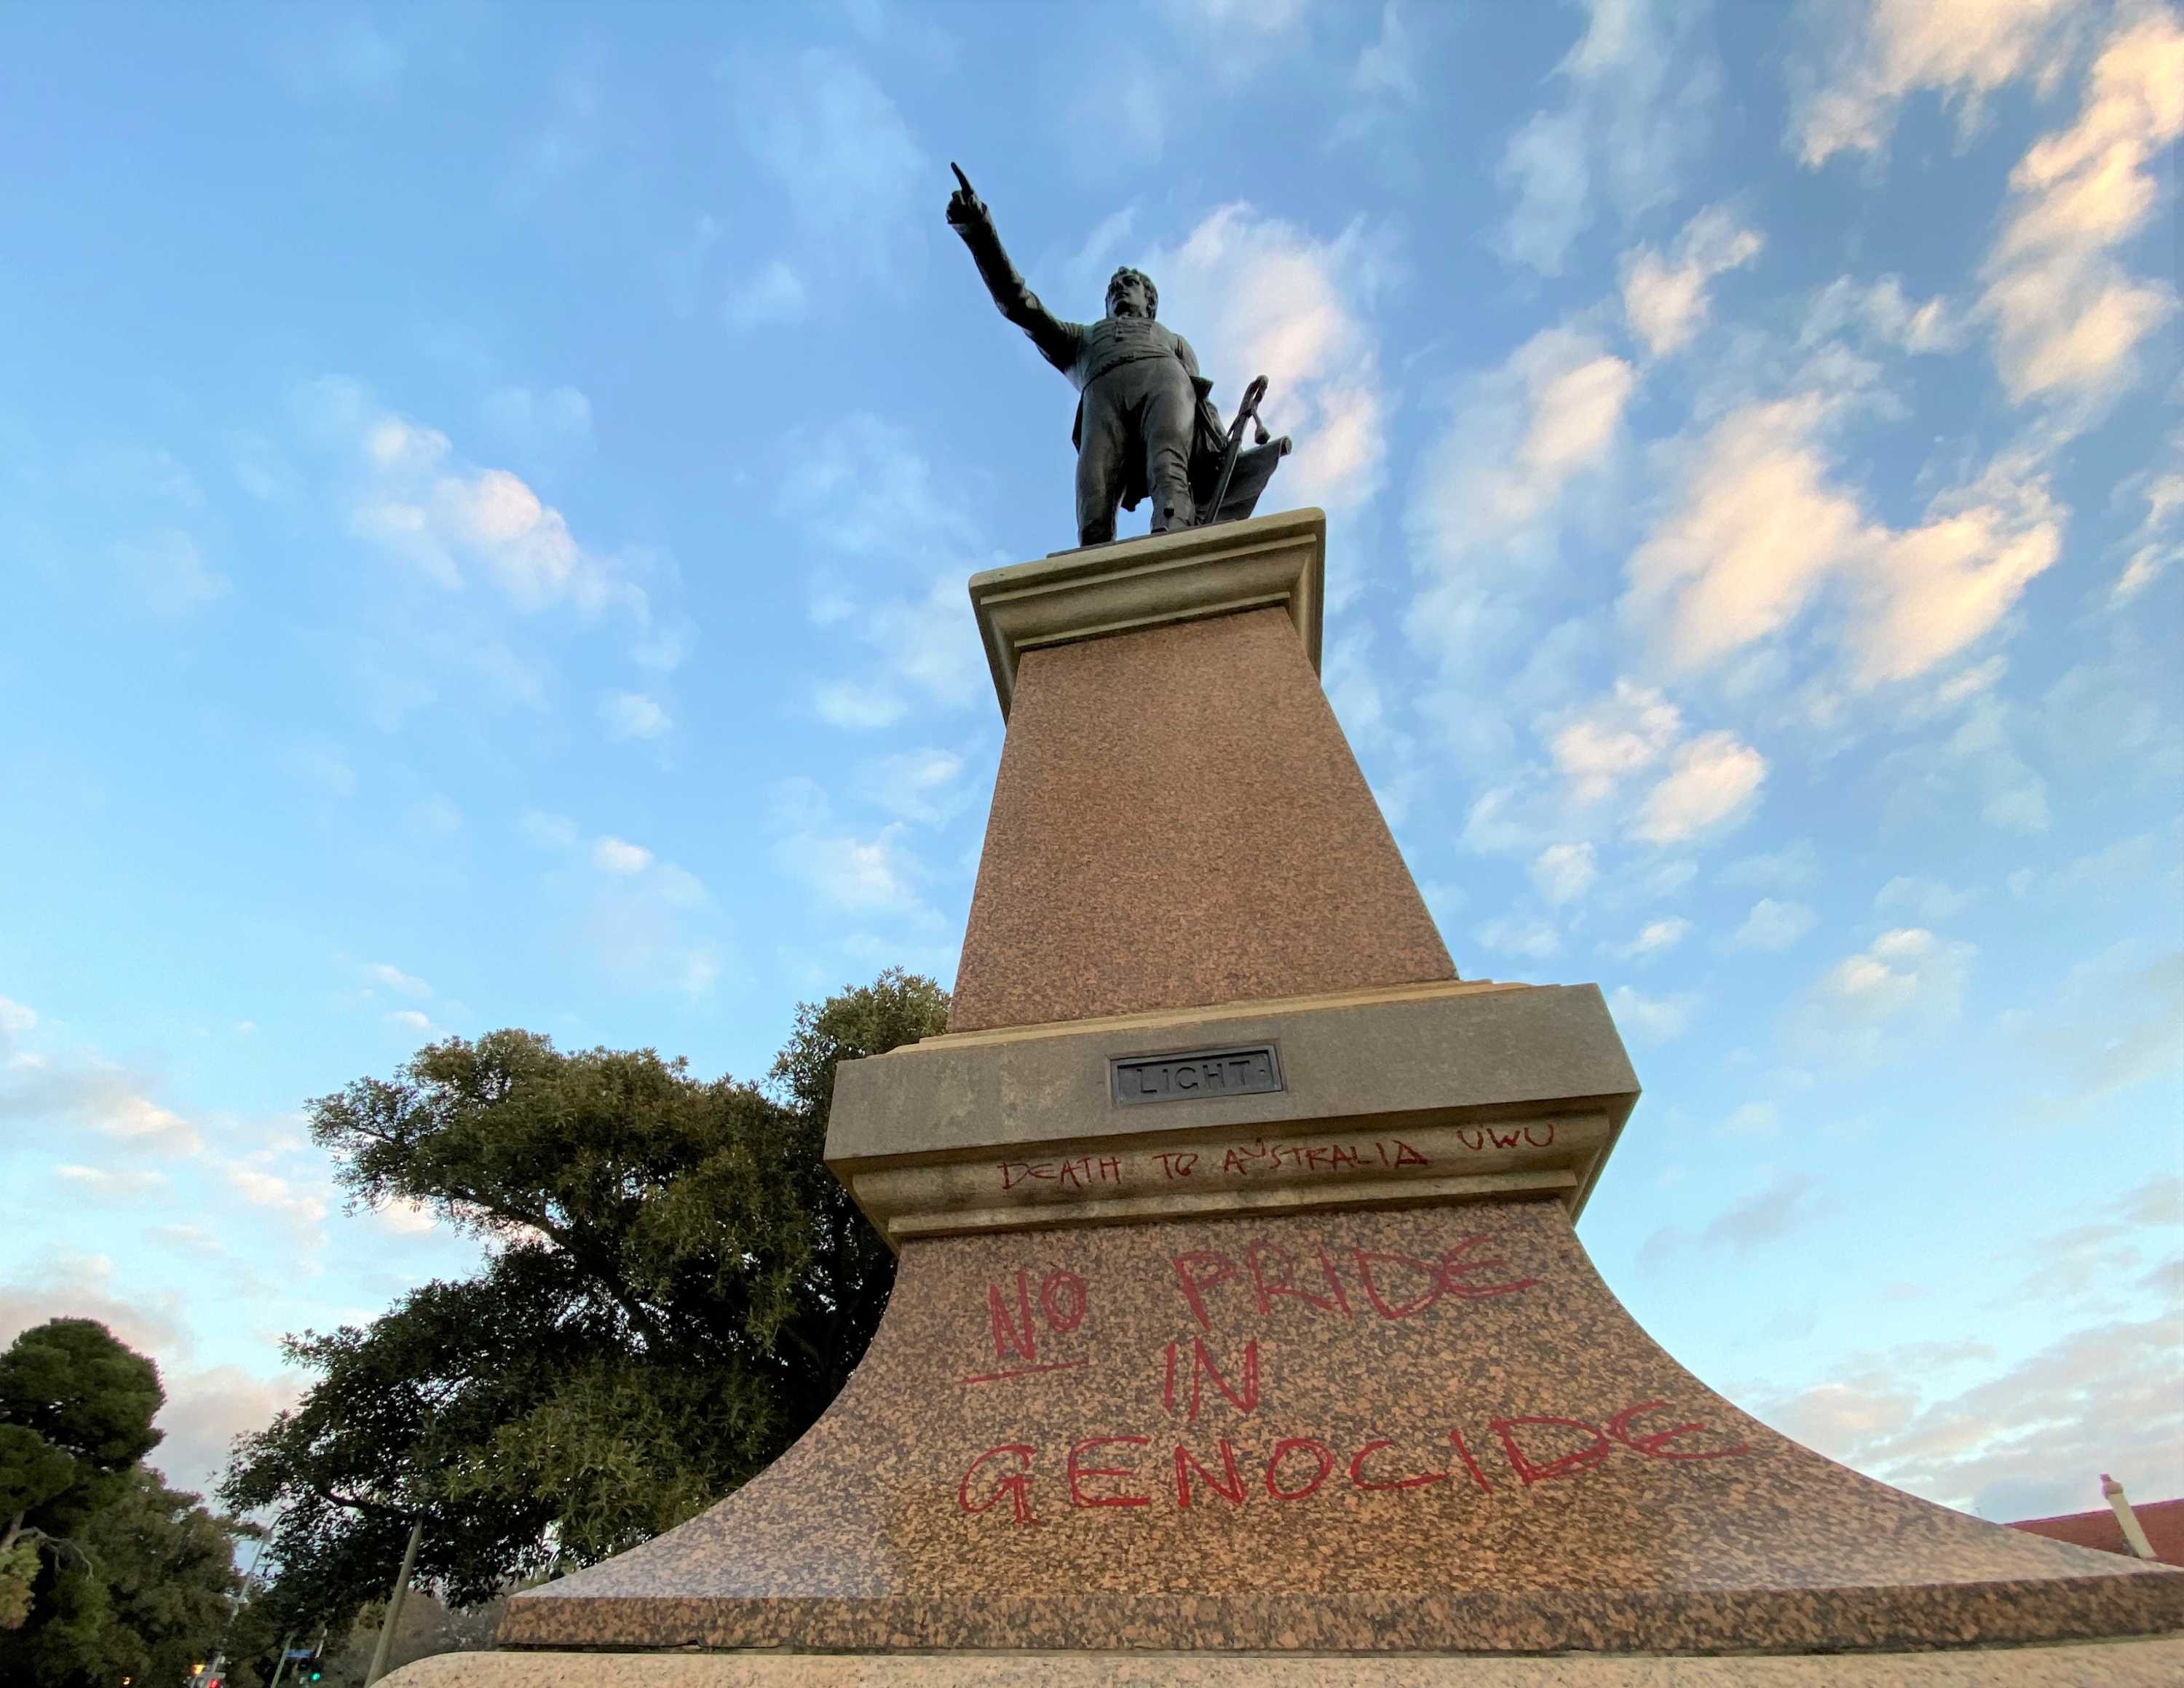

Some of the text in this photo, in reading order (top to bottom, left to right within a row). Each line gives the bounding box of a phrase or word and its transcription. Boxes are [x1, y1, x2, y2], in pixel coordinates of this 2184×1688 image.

[998, 1123, 1555, 1189] DEATH TO AUSTRALIA UWU
[988, 1237, 1543, 1360] NO PRIDE
[1163, 1338, 1259, 1421] IN
[957, 1400, 1748, 1526] GENOCIDE
